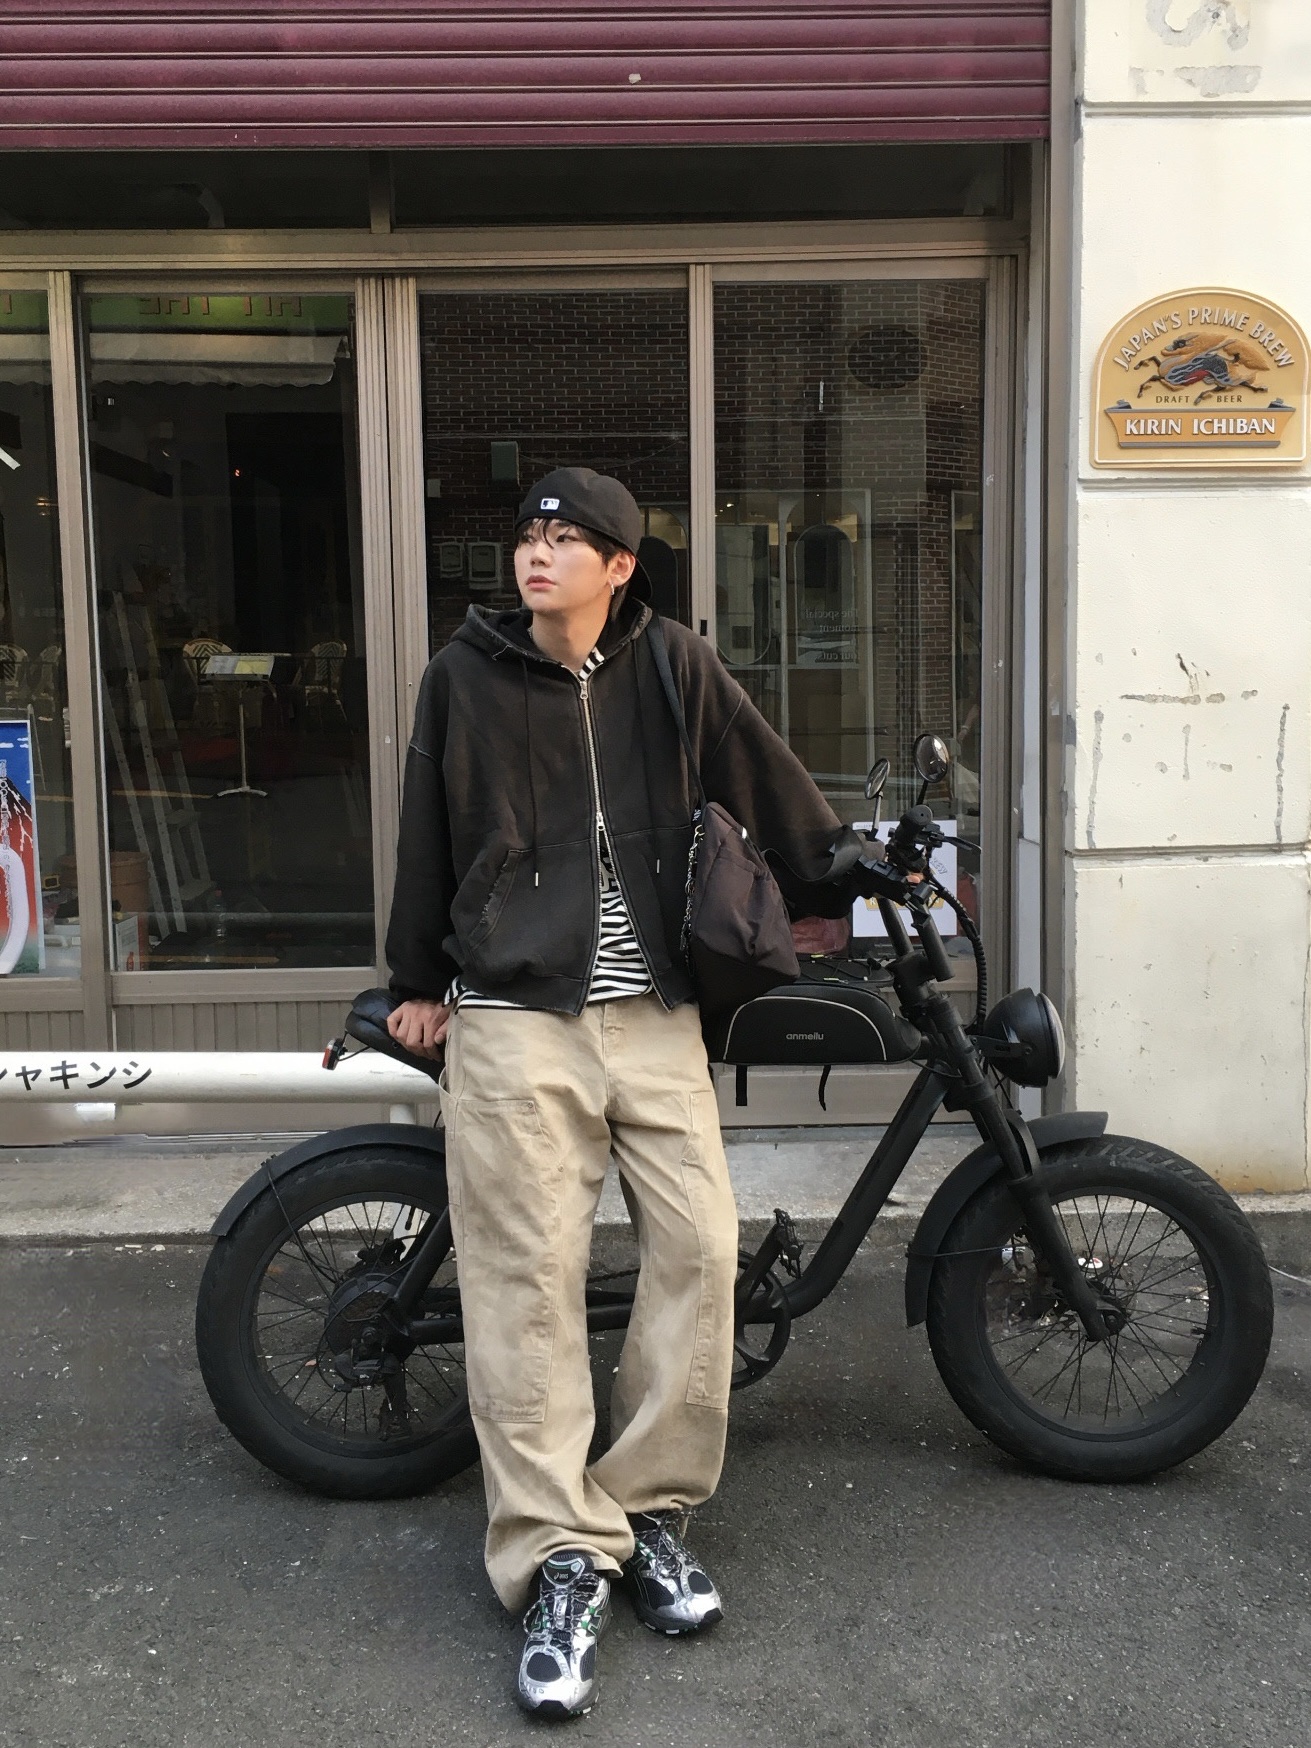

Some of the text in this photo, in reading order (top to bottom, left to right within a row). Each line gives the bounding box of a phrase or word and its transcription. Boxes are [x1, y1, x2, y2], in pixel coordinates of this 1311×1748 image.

[1113, 306, 1295, 372] JAPAN'S PRIME BREW
[1155, 394, 1243, 404] DRAFT BEER
[1125, 418, 1276, 435] KIRIN ICHIBAN
